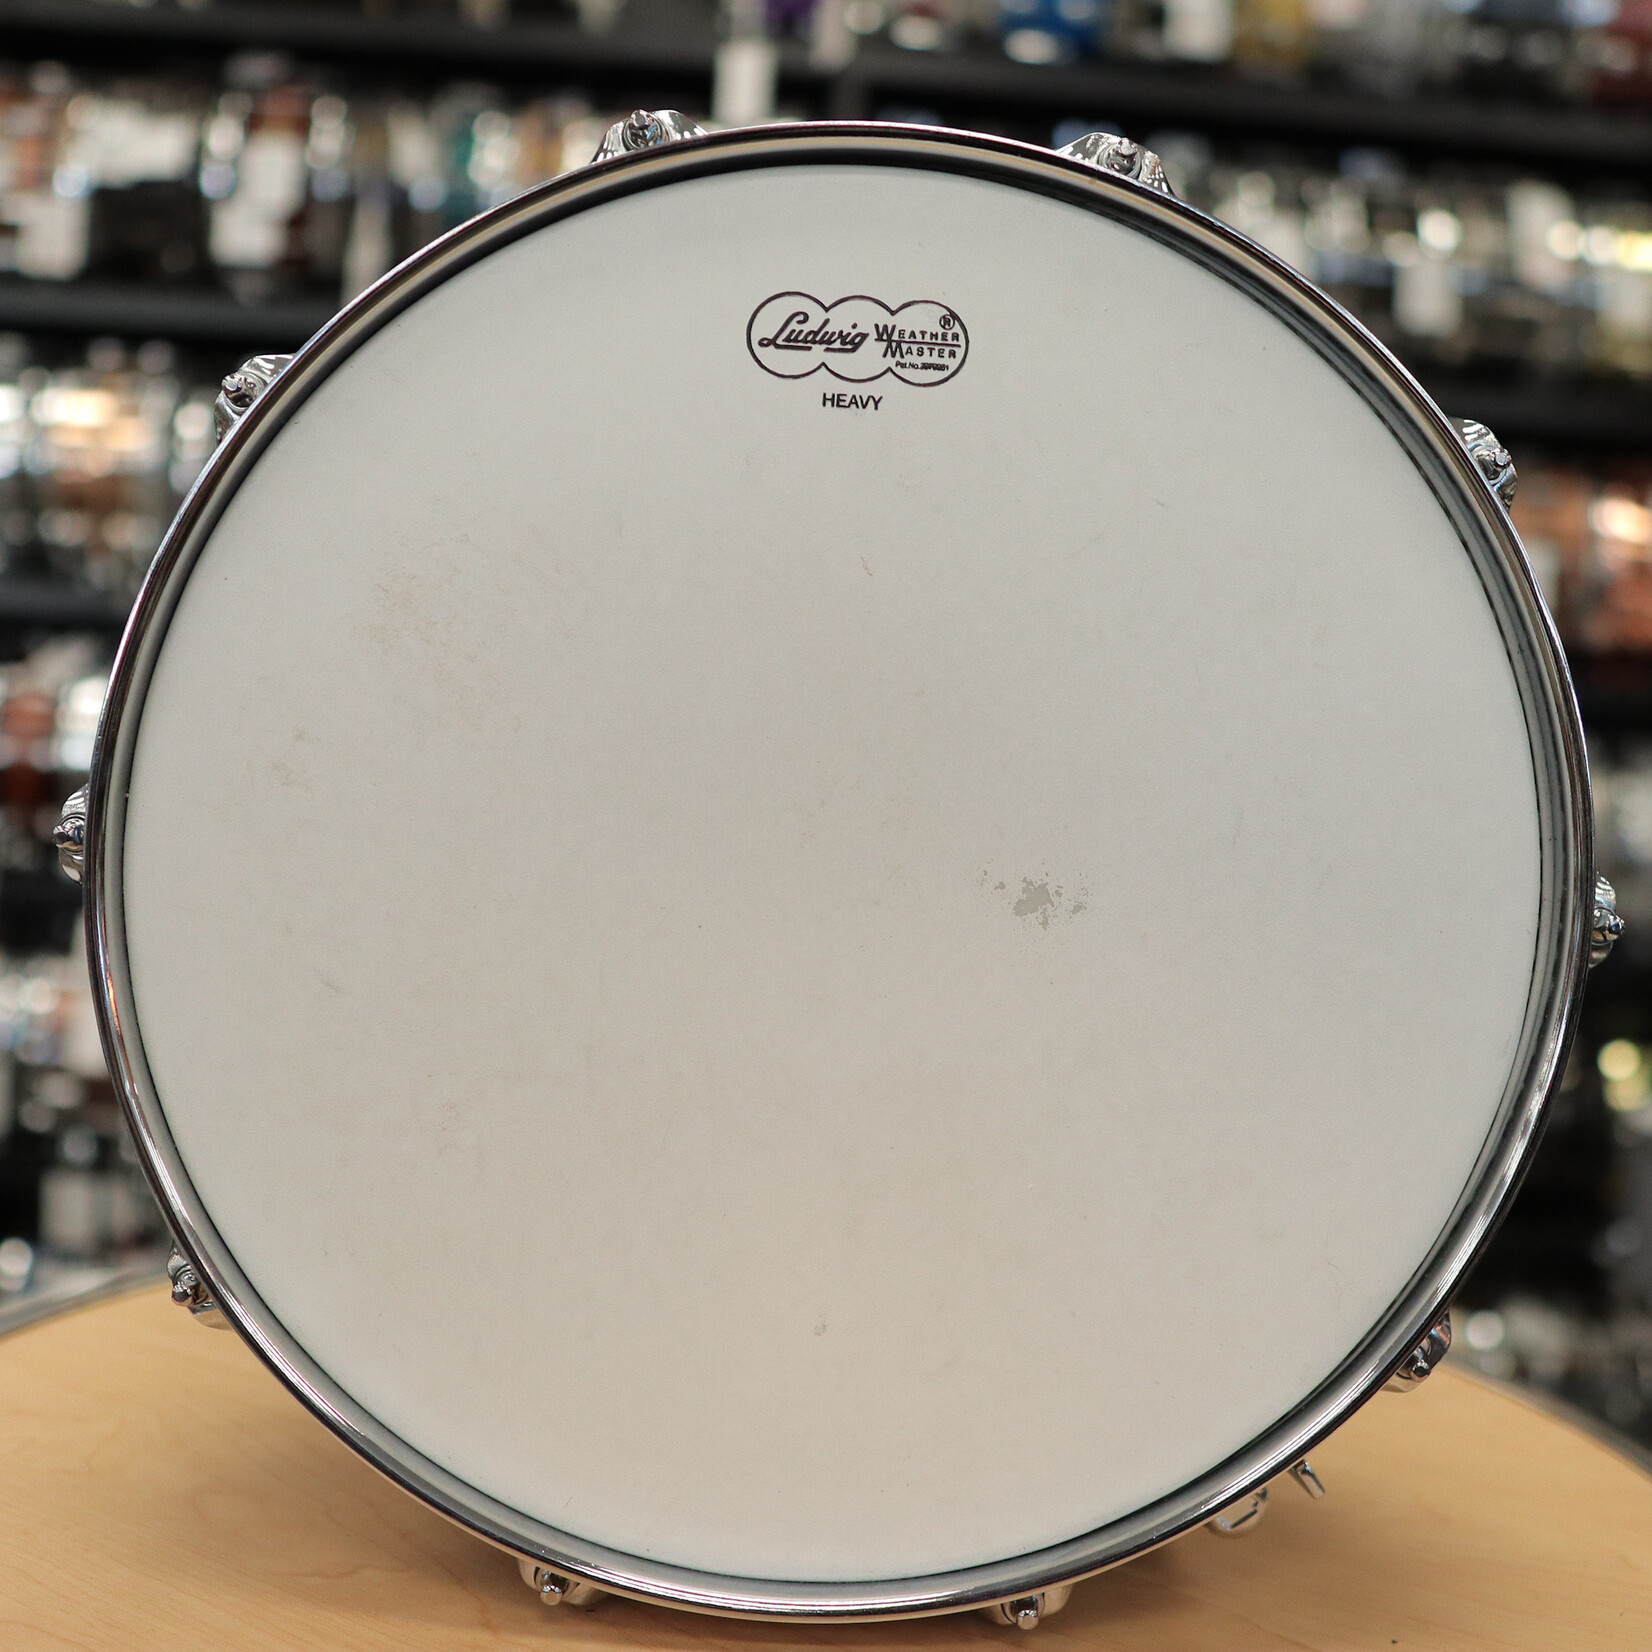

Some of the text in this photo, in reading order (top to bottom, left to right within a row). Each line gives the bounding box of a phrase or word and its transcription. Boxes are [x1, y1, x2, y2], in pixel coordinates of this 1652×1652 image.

[758, 311, 869, 353] Ludwig
[874, 323, 960, 342] WEATHER
[882, 342, 957, 359] MASTER
[822, 393, 883, 411] HEAVY
